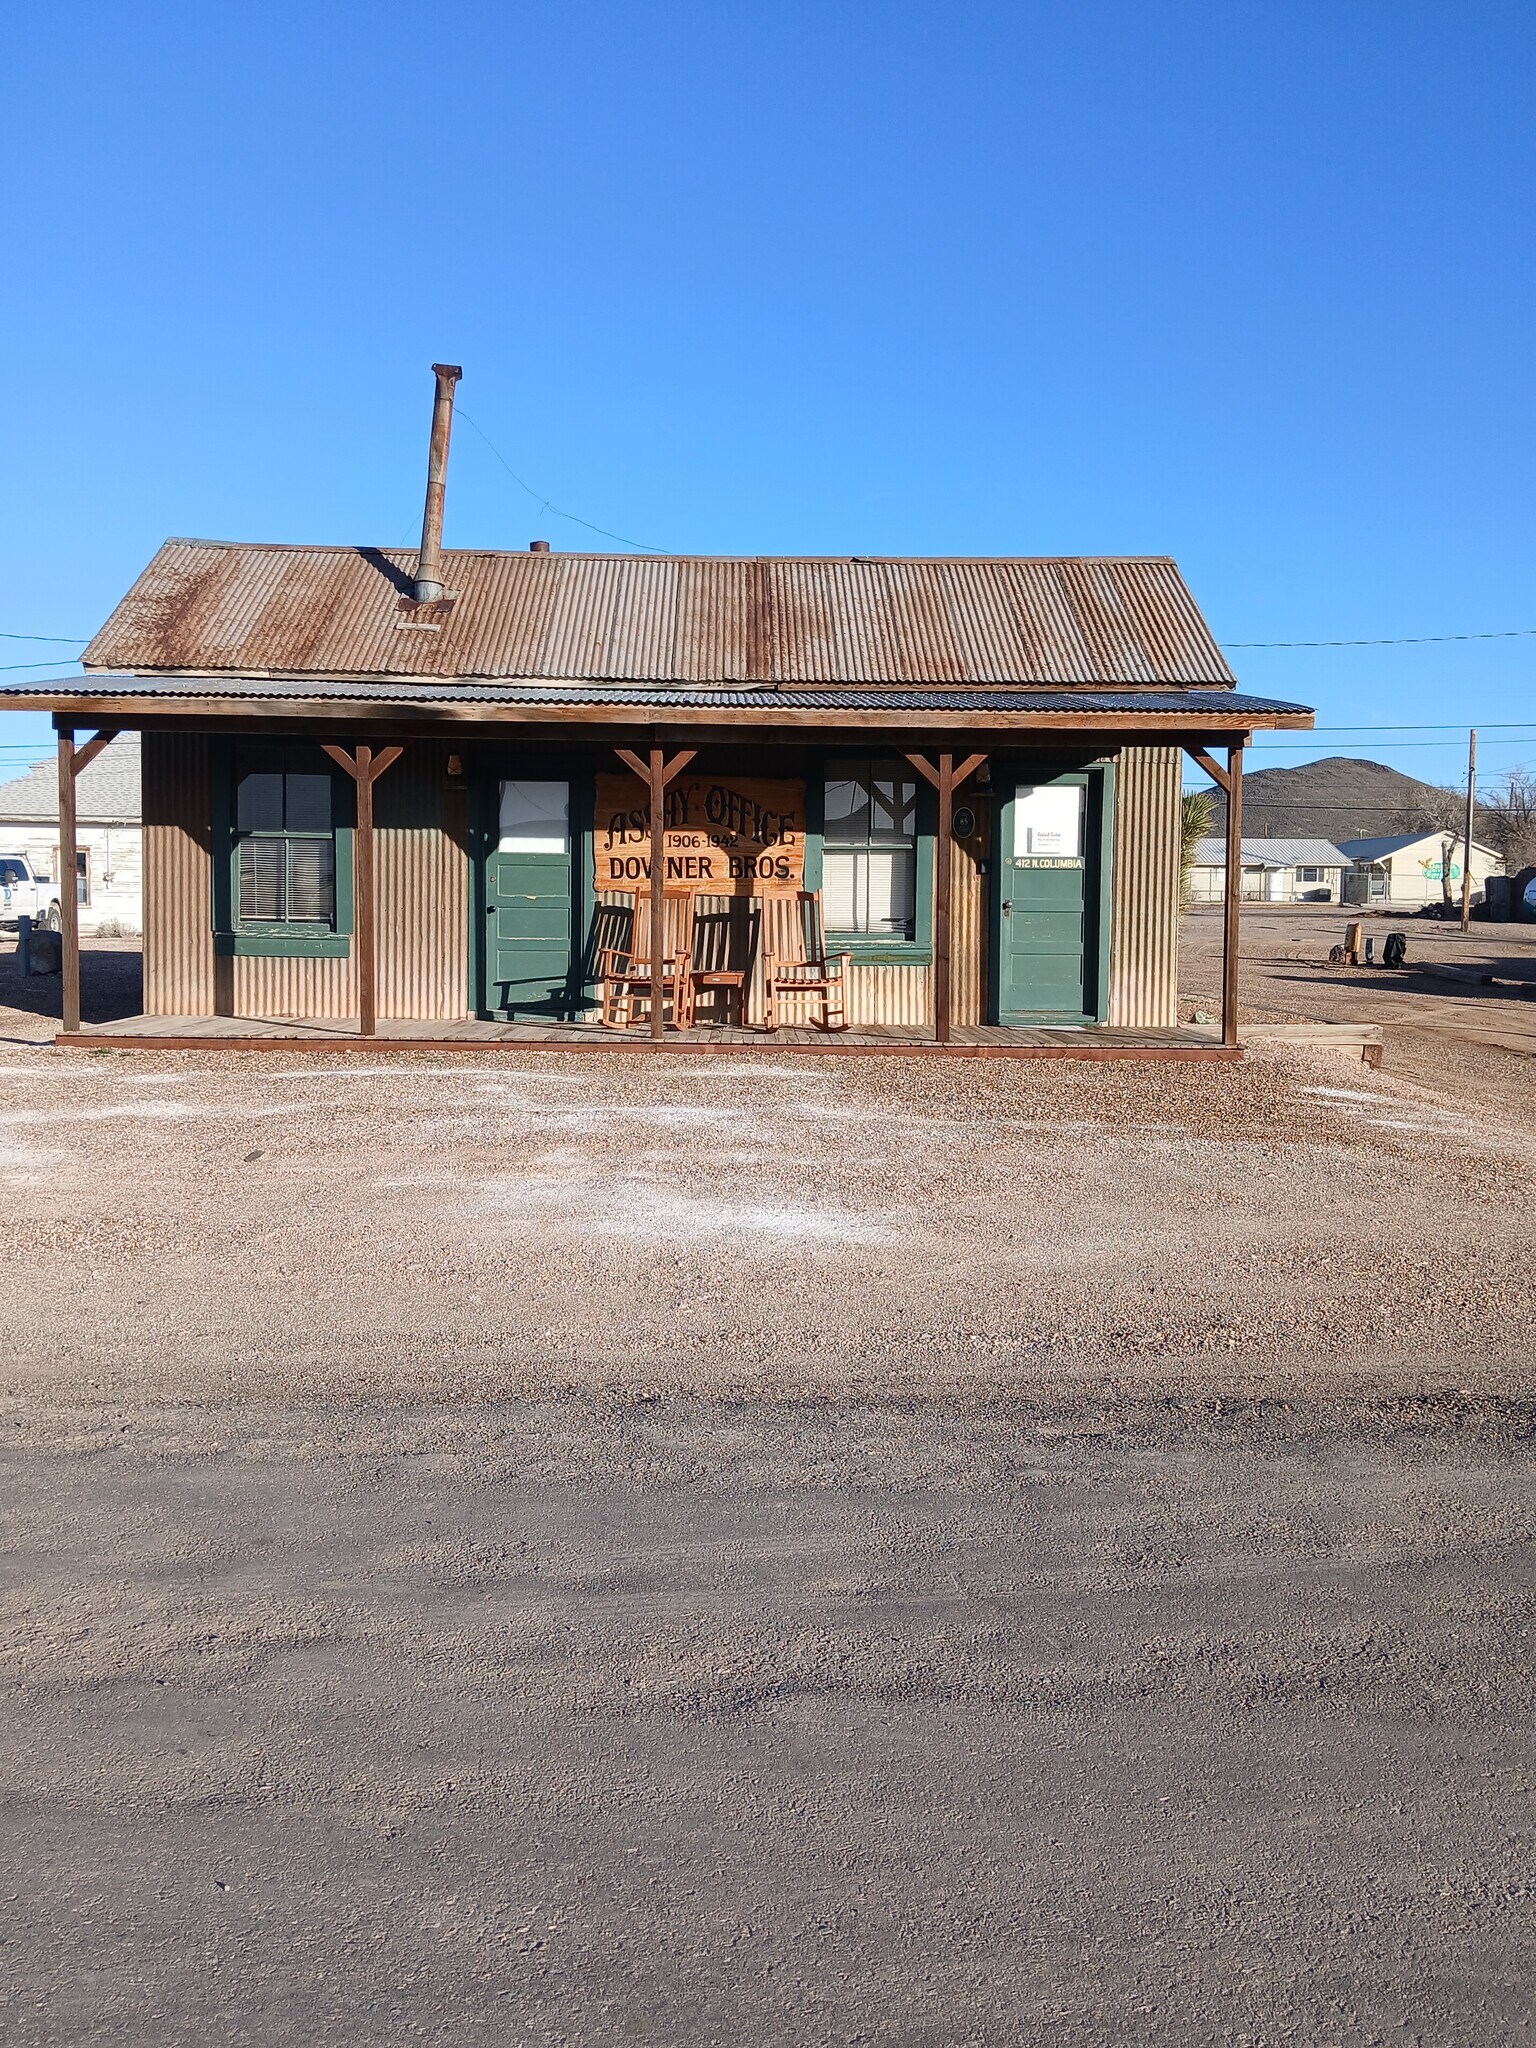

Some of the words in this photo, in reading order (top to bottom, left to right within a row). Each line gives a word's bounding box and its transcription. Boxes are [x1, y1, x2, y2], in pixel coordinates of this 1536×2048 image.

[703, 785, 796, 847] OFFICE
[729, 855, 795, 879] BROS.
[1015, 859, 1030, 868] 412
